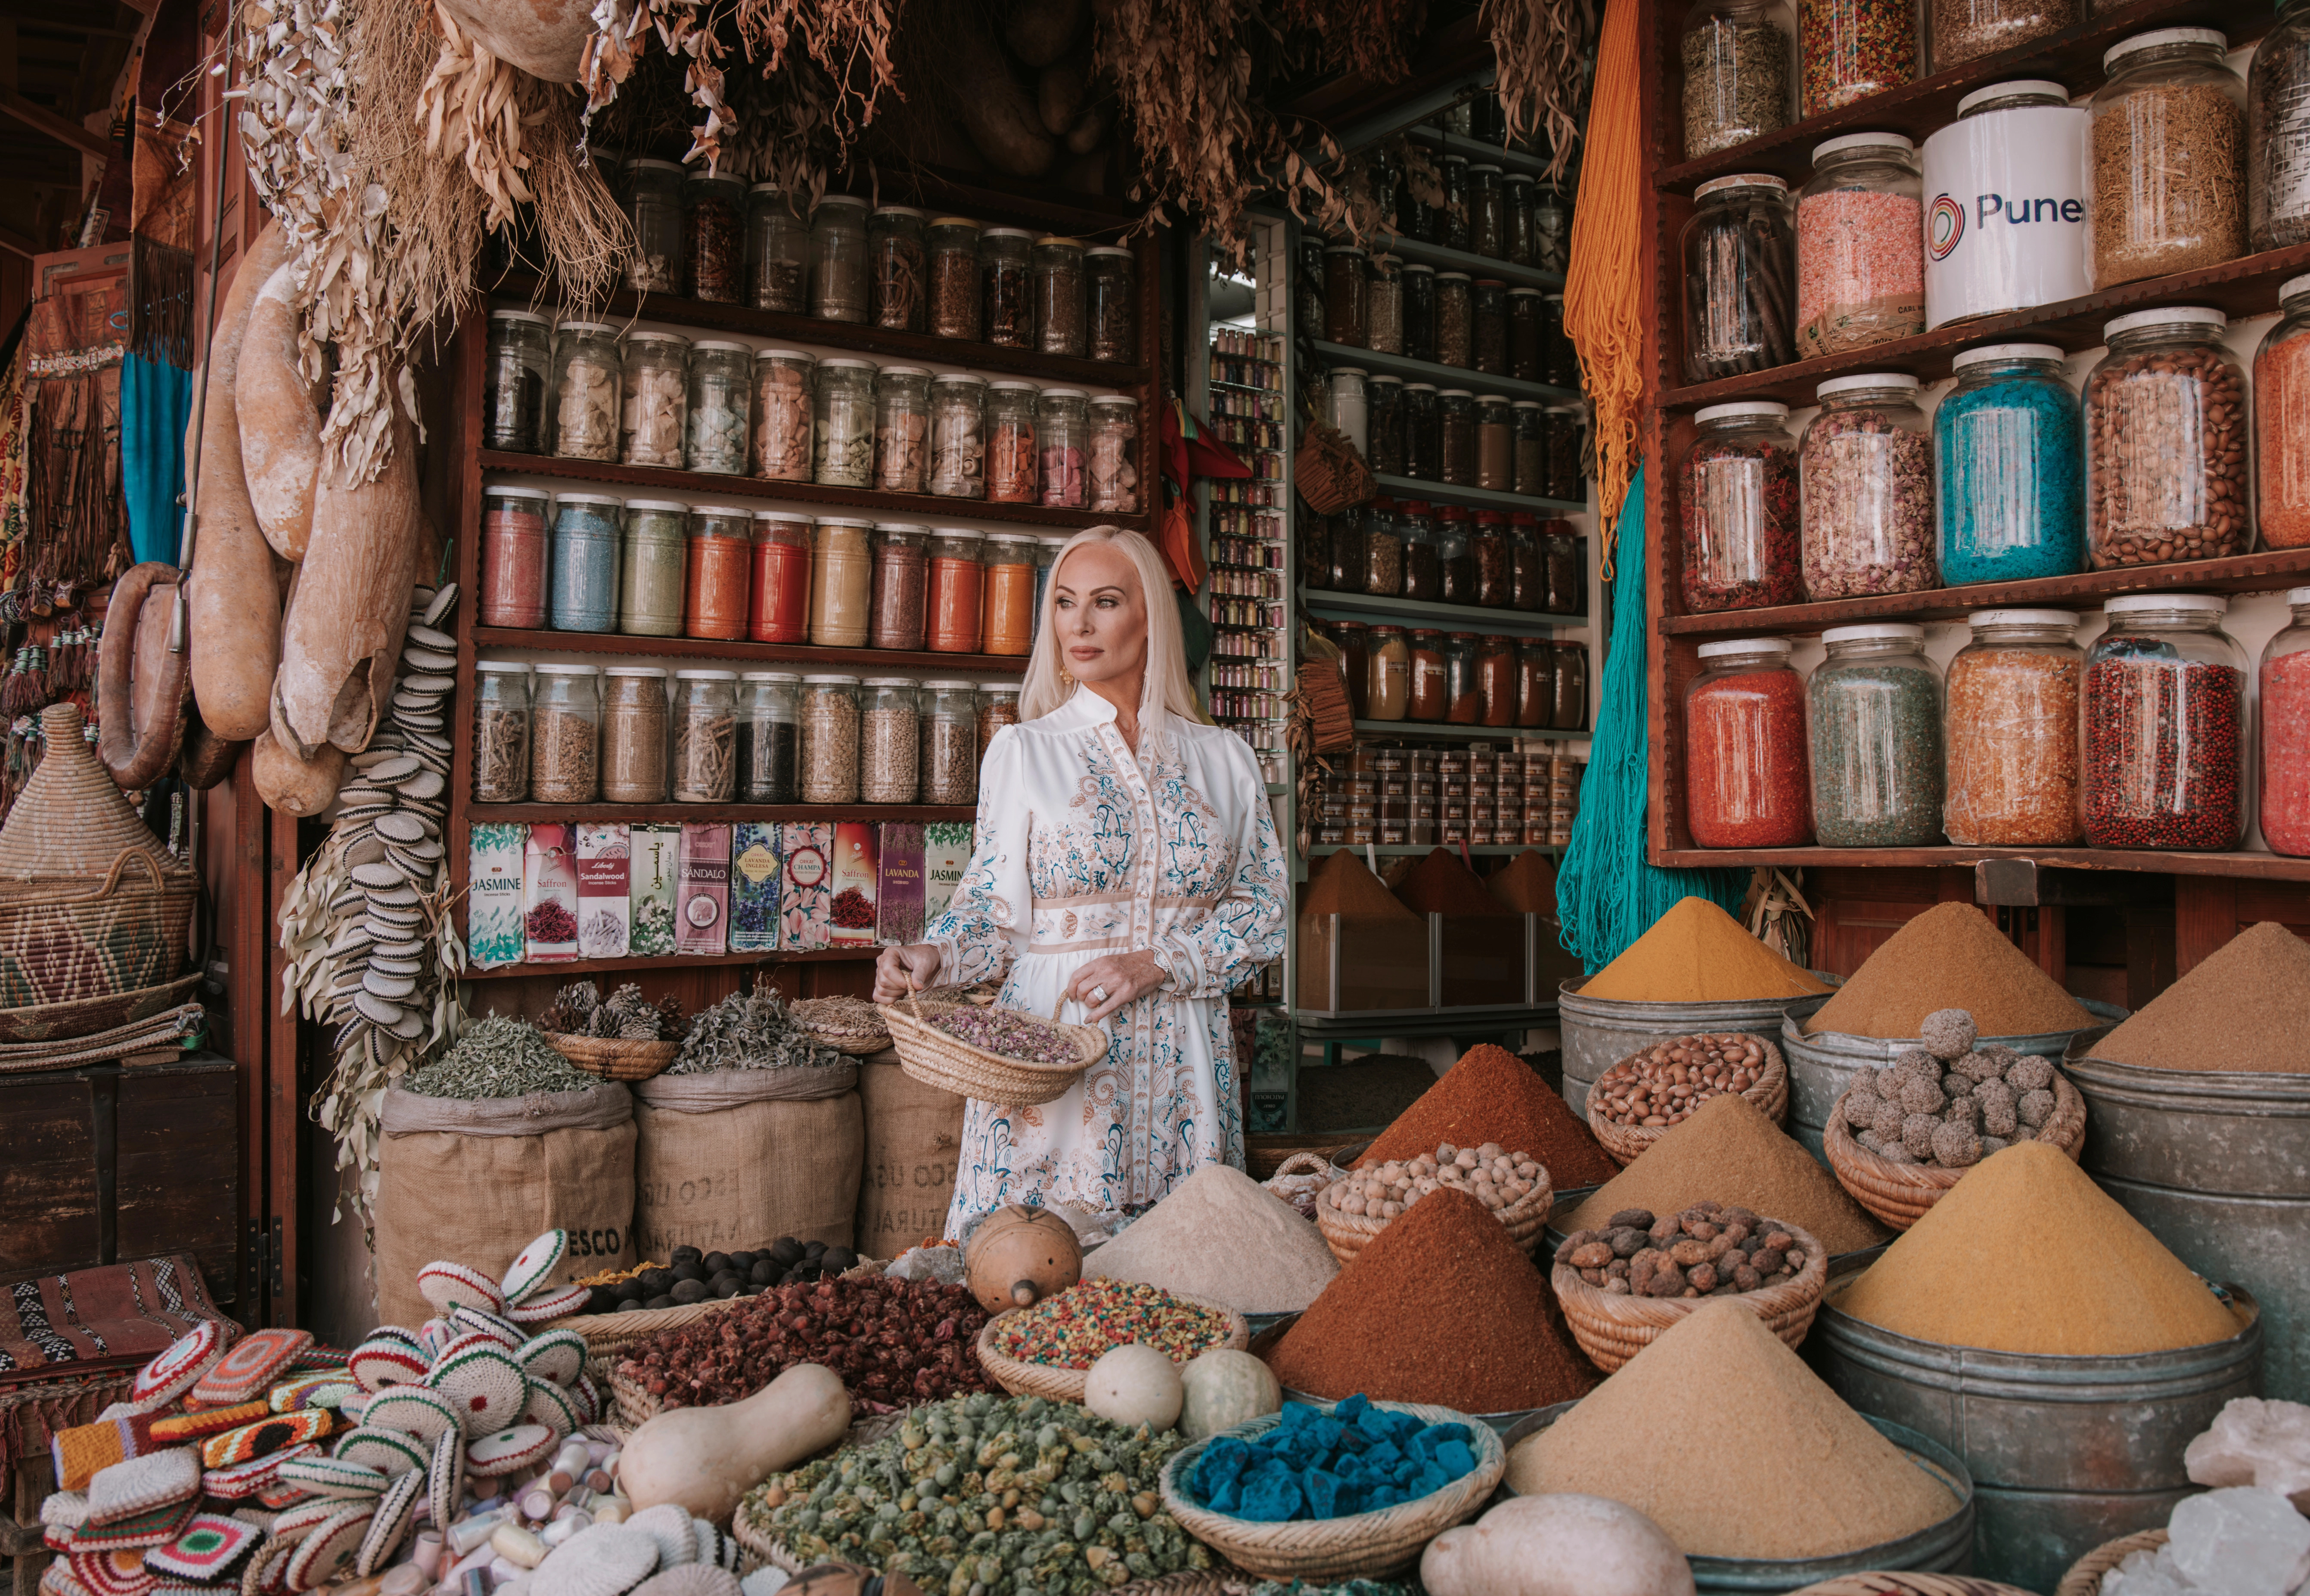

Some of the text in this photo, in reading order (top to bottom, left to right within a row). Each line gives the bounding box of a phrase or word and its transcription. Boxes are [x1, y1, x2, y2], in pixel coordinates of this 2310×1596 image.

[1977, 193, 2083, 229] Pune
[1898, 306, 1916, 314] CARL
[682, 866, 726, 879] SÁNDALO
[842, 869, 869, 878] Saffron
[885, 868, 919, 878] LAVANDA
[930, 870, 963, 881] JASMIN
[473, 878, 520, 891] JASMINE
[537, 879, 567, 888] Saffron
[568, 1228, 620, 1257] ESCO
